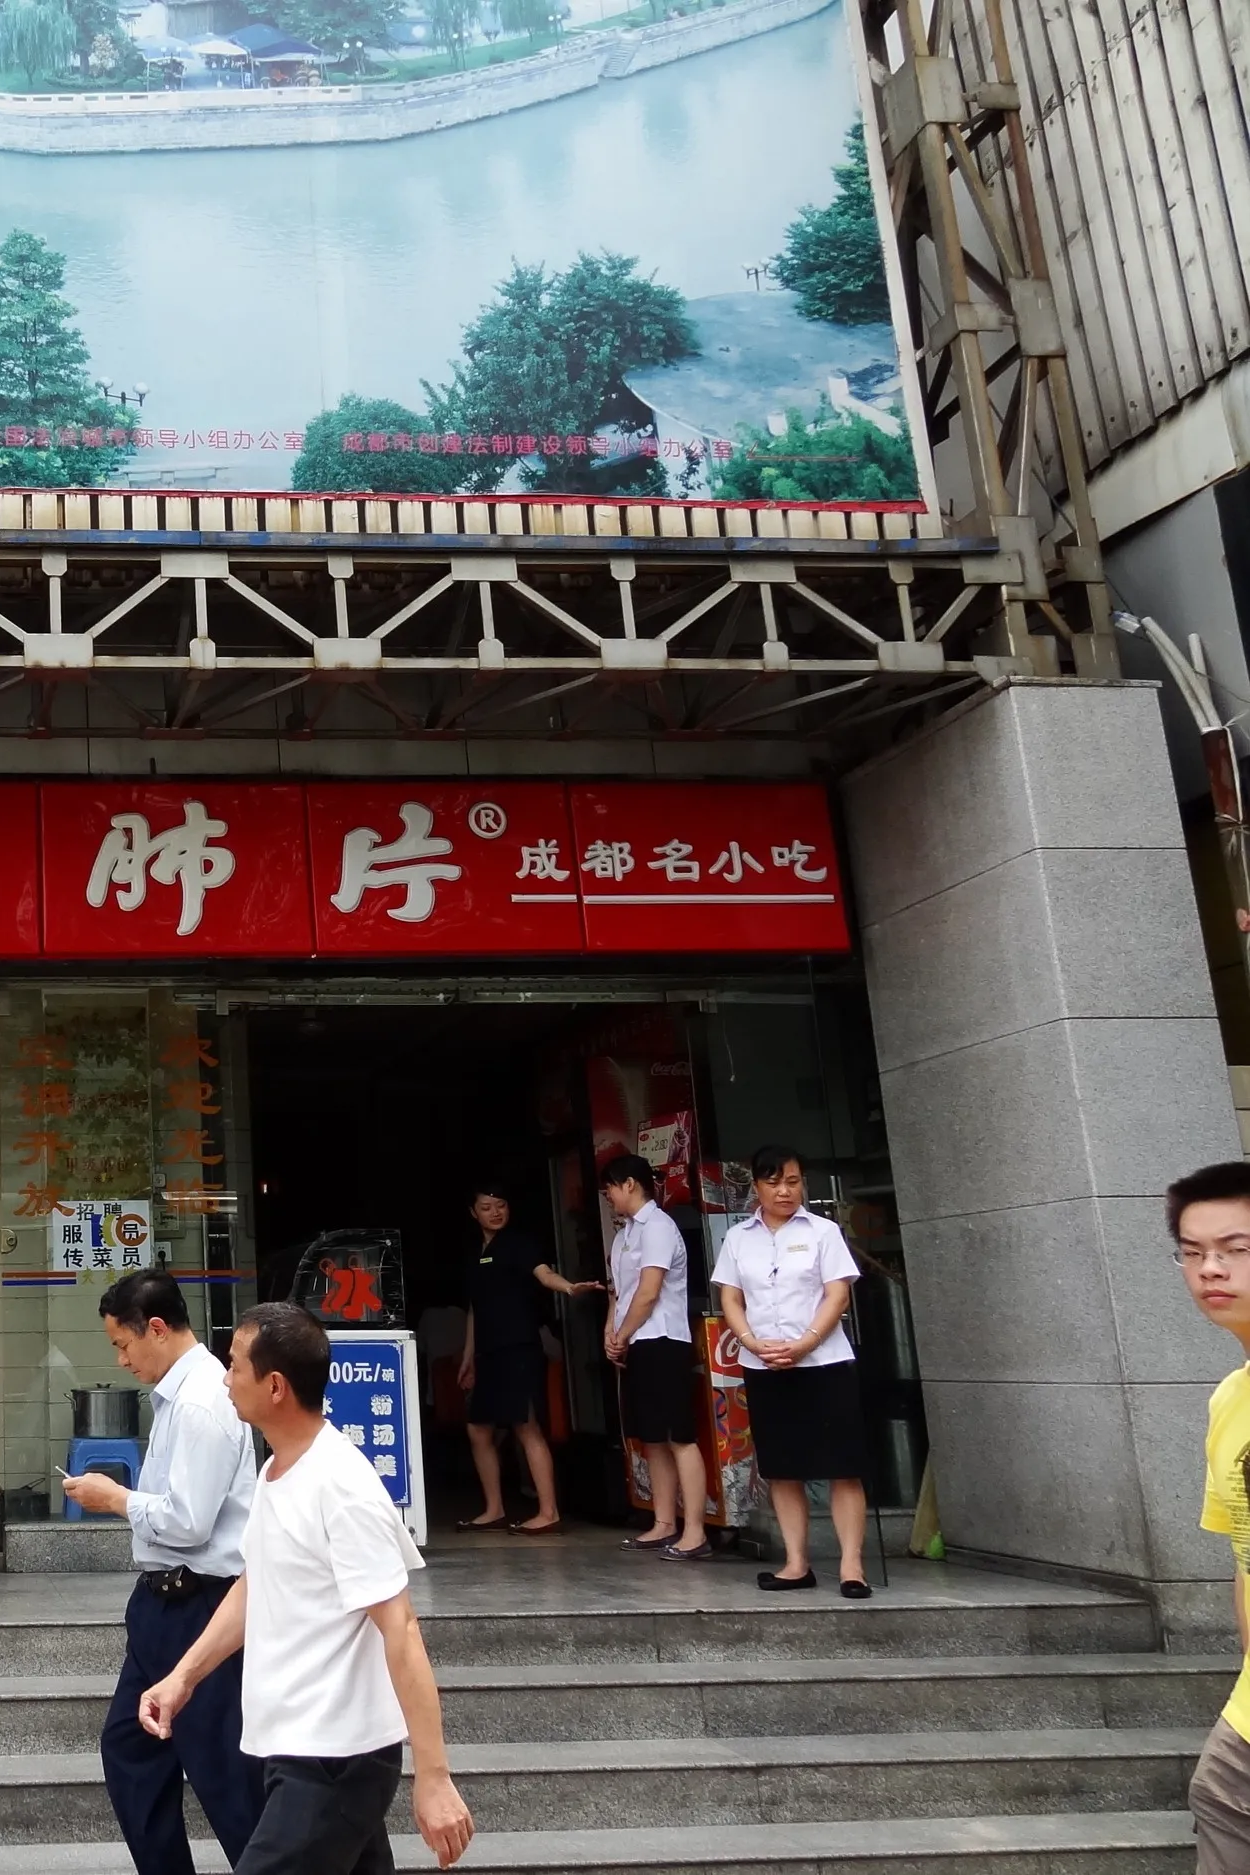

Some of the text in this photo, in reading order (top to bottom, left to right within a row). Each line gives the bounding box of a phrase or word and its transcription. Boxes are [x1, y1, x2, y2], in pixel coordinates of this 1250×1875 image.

[516, 838, 828, 884] 成都名小吃
[76, 1203, 123, 1221] 招聘
[62, 1223, 141, 1245] 服员
[62, 1247, 142, 1268] 传菜员
[319, 1257, 382, 1320] 冰
